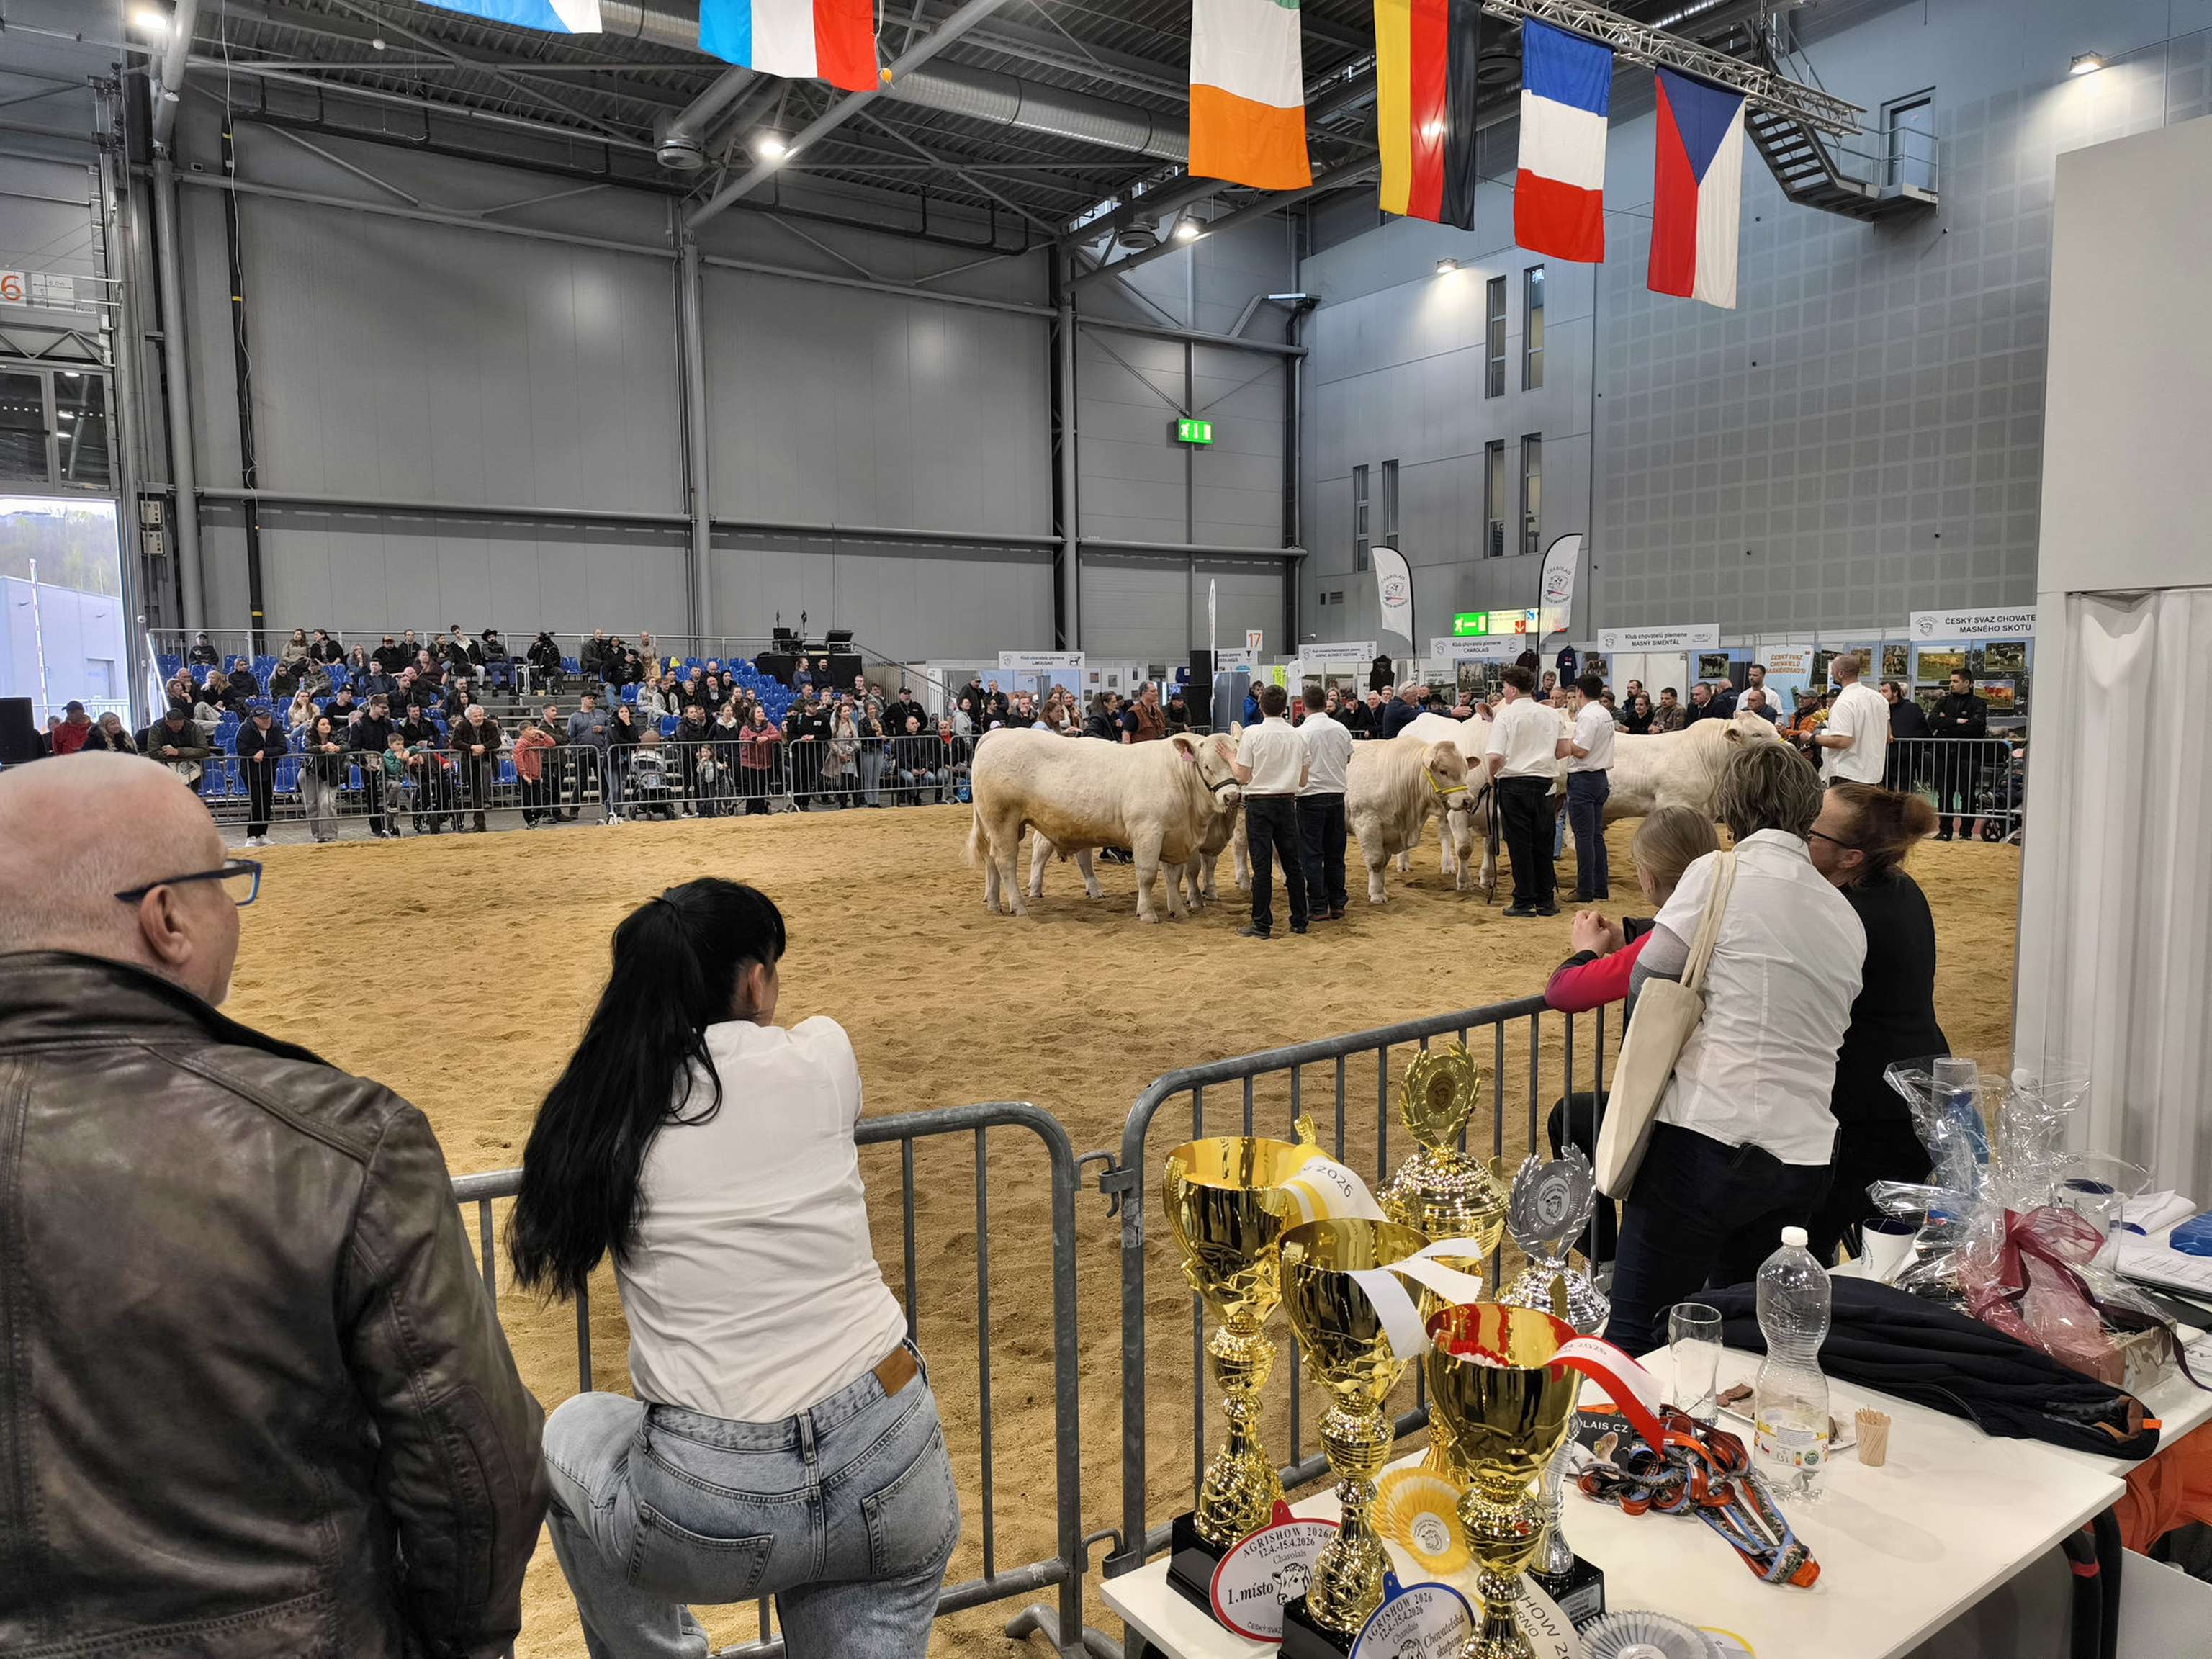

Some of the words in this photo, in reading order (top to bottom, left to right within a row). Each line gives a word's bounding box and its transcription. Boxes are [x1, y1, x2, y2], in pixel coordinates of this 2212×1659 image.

[1945, 616, 1972, 625] ČESKÝ
[1959, 624, 2000, 633] MASNÉHO
[1248, 634, 1262, 647] 17
[1583, 1421, 1609, 1431] LAIS
[1613, 1424, 1629, 1433] CZ
[1244, 1527, 1301, 1558] AGRISHOW
[1307, 1527, 1328, 1538] 2026
[1273, 1550, 1307, 1565] Charolais
[1367, 1596, 1411, 1642] AGRISHOW
[1414, 1592, 1433, 1604] 2026
[1516, 1611, 1539, 1637] RNO
[1519, 1596, 1561, 1637] HOW
[1393, 1622, 1419, 1645] Charolais
[1423, 1609, 1465, 1649] Chovatelská
[1436, 1633, 1464, 1658] skupina
